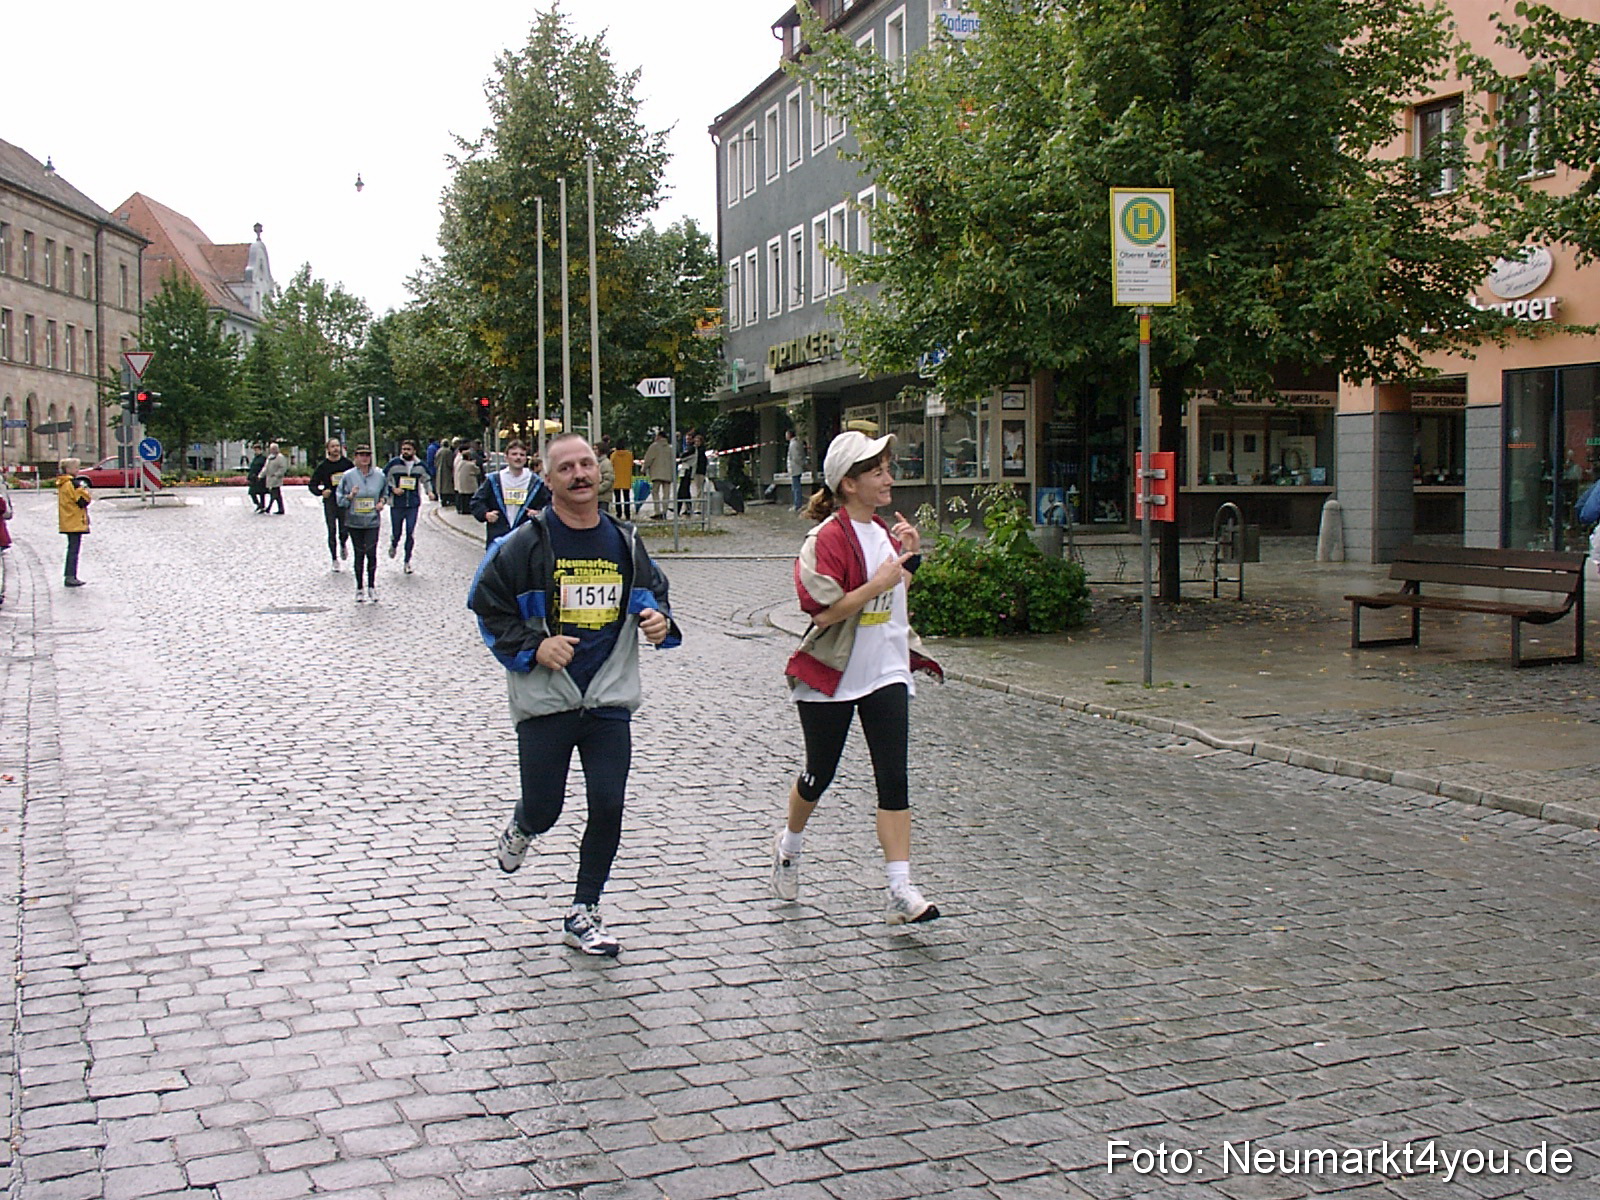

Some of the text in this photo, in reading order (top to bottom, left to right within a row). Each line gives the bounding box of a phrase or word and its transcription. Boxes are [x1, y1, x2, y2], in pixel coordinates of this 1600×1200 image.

[1133, 208, 1154, 234] H
[1119, 250, 1168, 259] Oberer Markt
[646, 380, 667, 395] WC
[556, 558, 619, 571] Neumarkter
[575, 585, 617, 606] 1514
